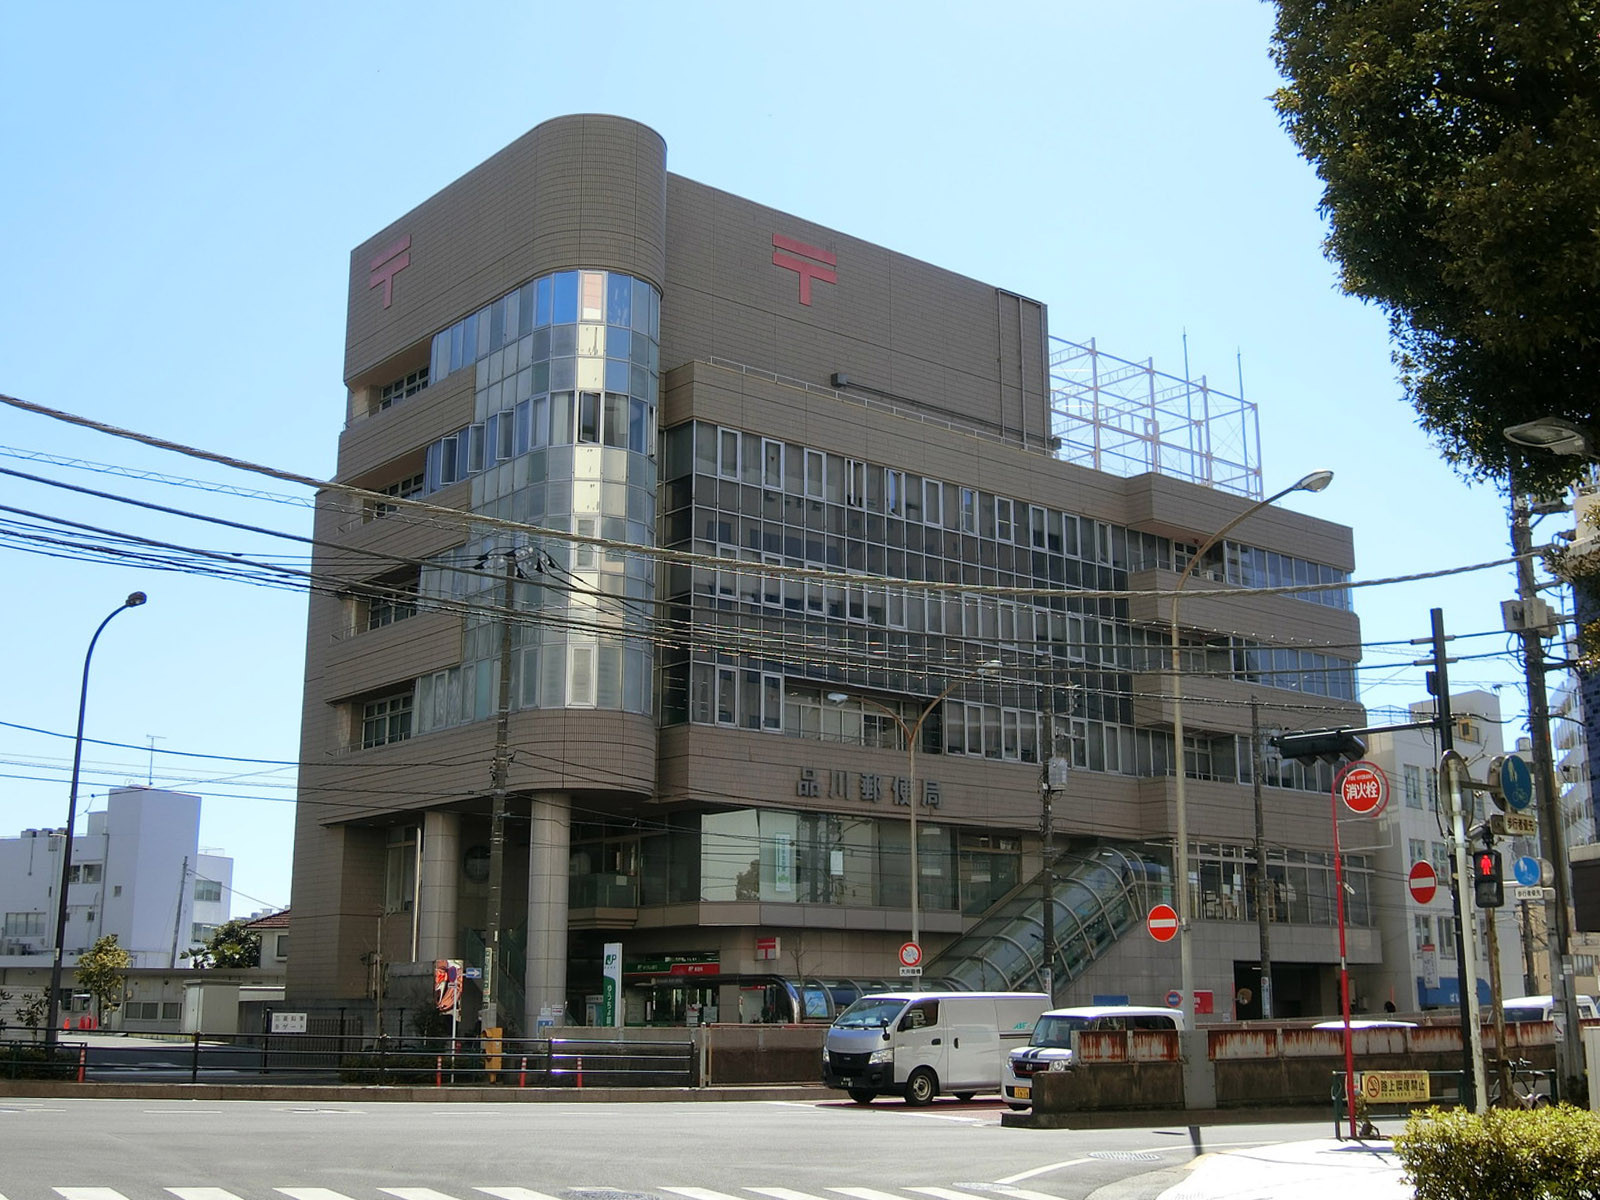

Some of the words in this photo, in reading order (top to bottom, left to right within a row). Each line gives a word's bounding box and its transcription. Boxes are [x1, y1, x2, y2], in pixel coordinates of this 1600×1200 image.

[797, 767, 941, 809] 品川郵便局
[1345, 781, 1378, 800] 消火栓
[1507, 817, 1534, 831] 歩行者優先
[1381, 1080, 1425, 1092] 路上喫煙禁止
